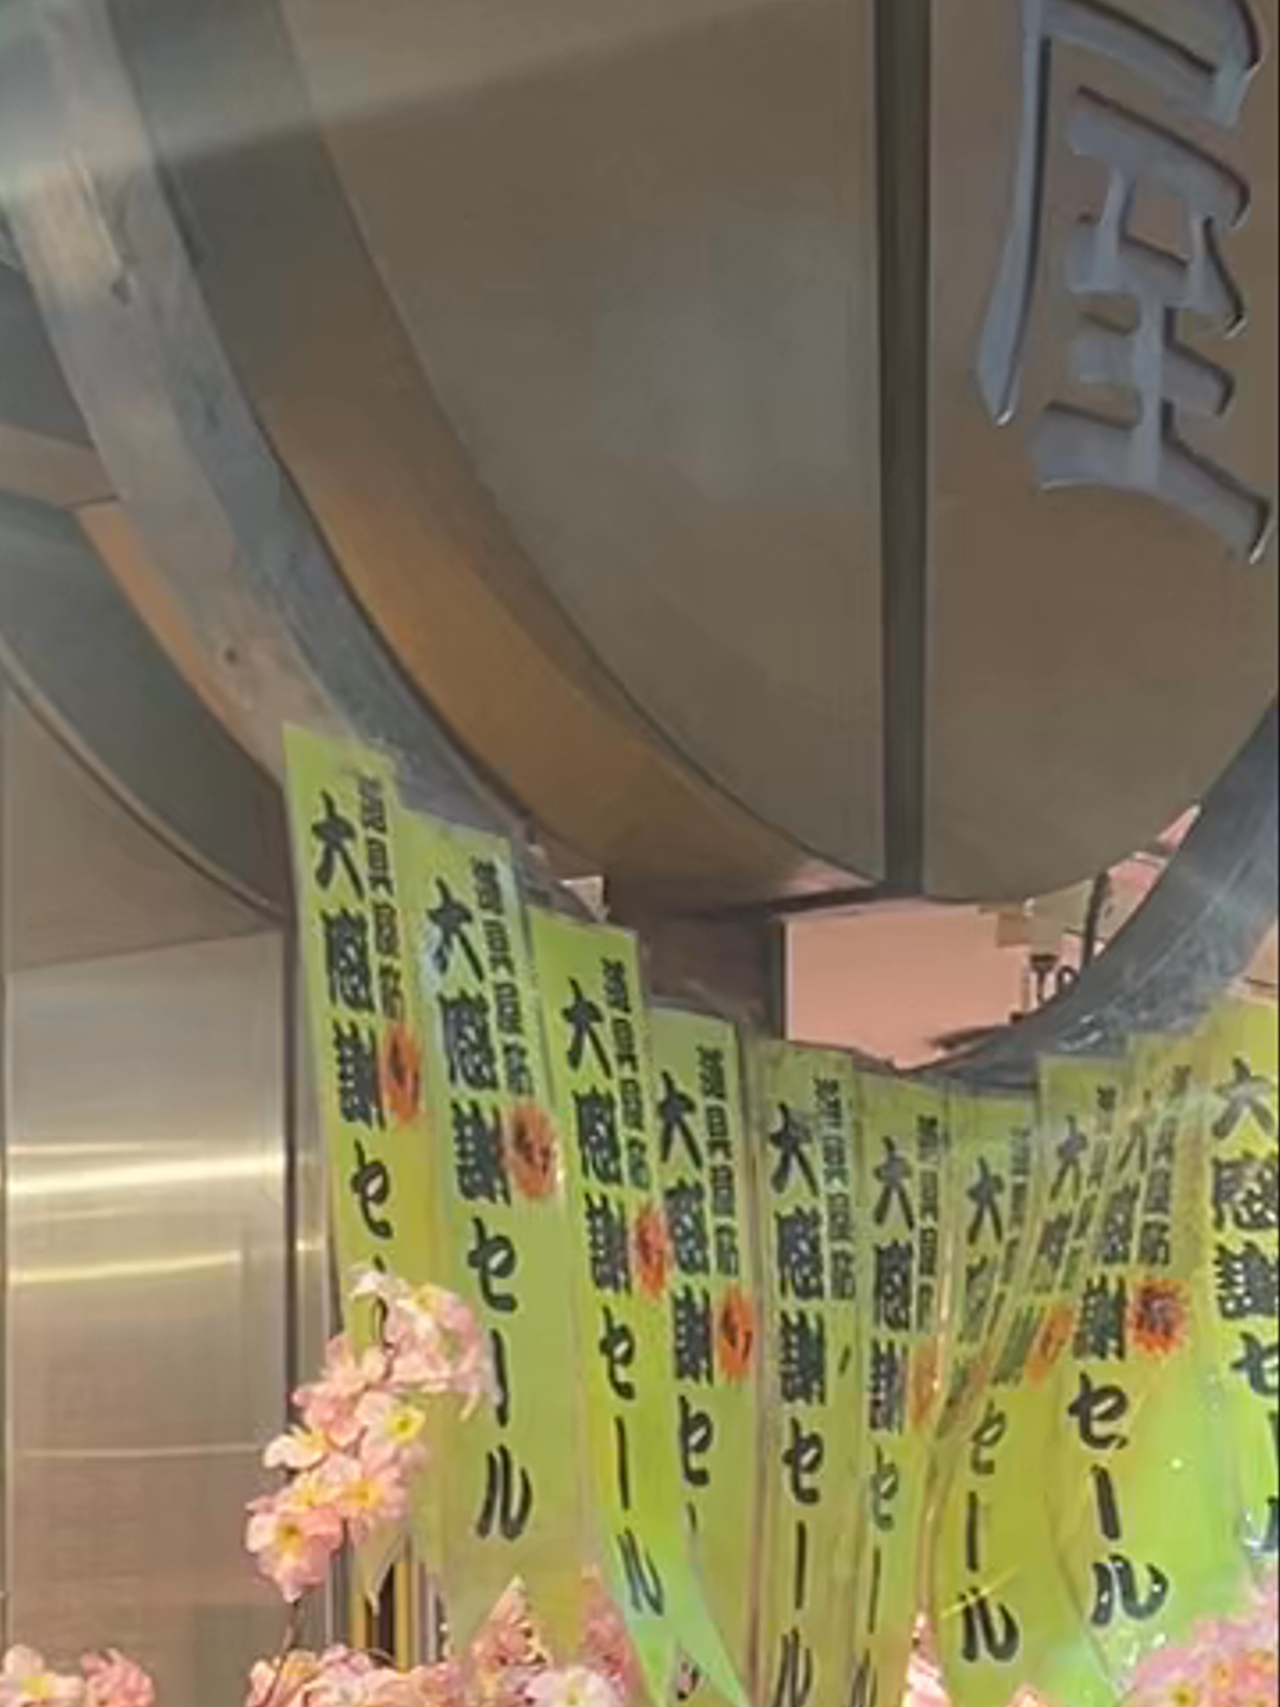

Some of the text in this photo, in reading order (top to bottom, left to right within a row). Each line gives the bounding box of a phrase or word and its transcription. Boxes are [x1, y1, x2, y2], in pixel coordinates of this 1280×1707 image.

[311, 790, 394, 1271] 大感謝セ
[426, 876, 534, 1542] 大感謝セール
[561, 976, 664, 1616] 大感謝セール
[656, 1070, 716, 1699] 大感謝セ
